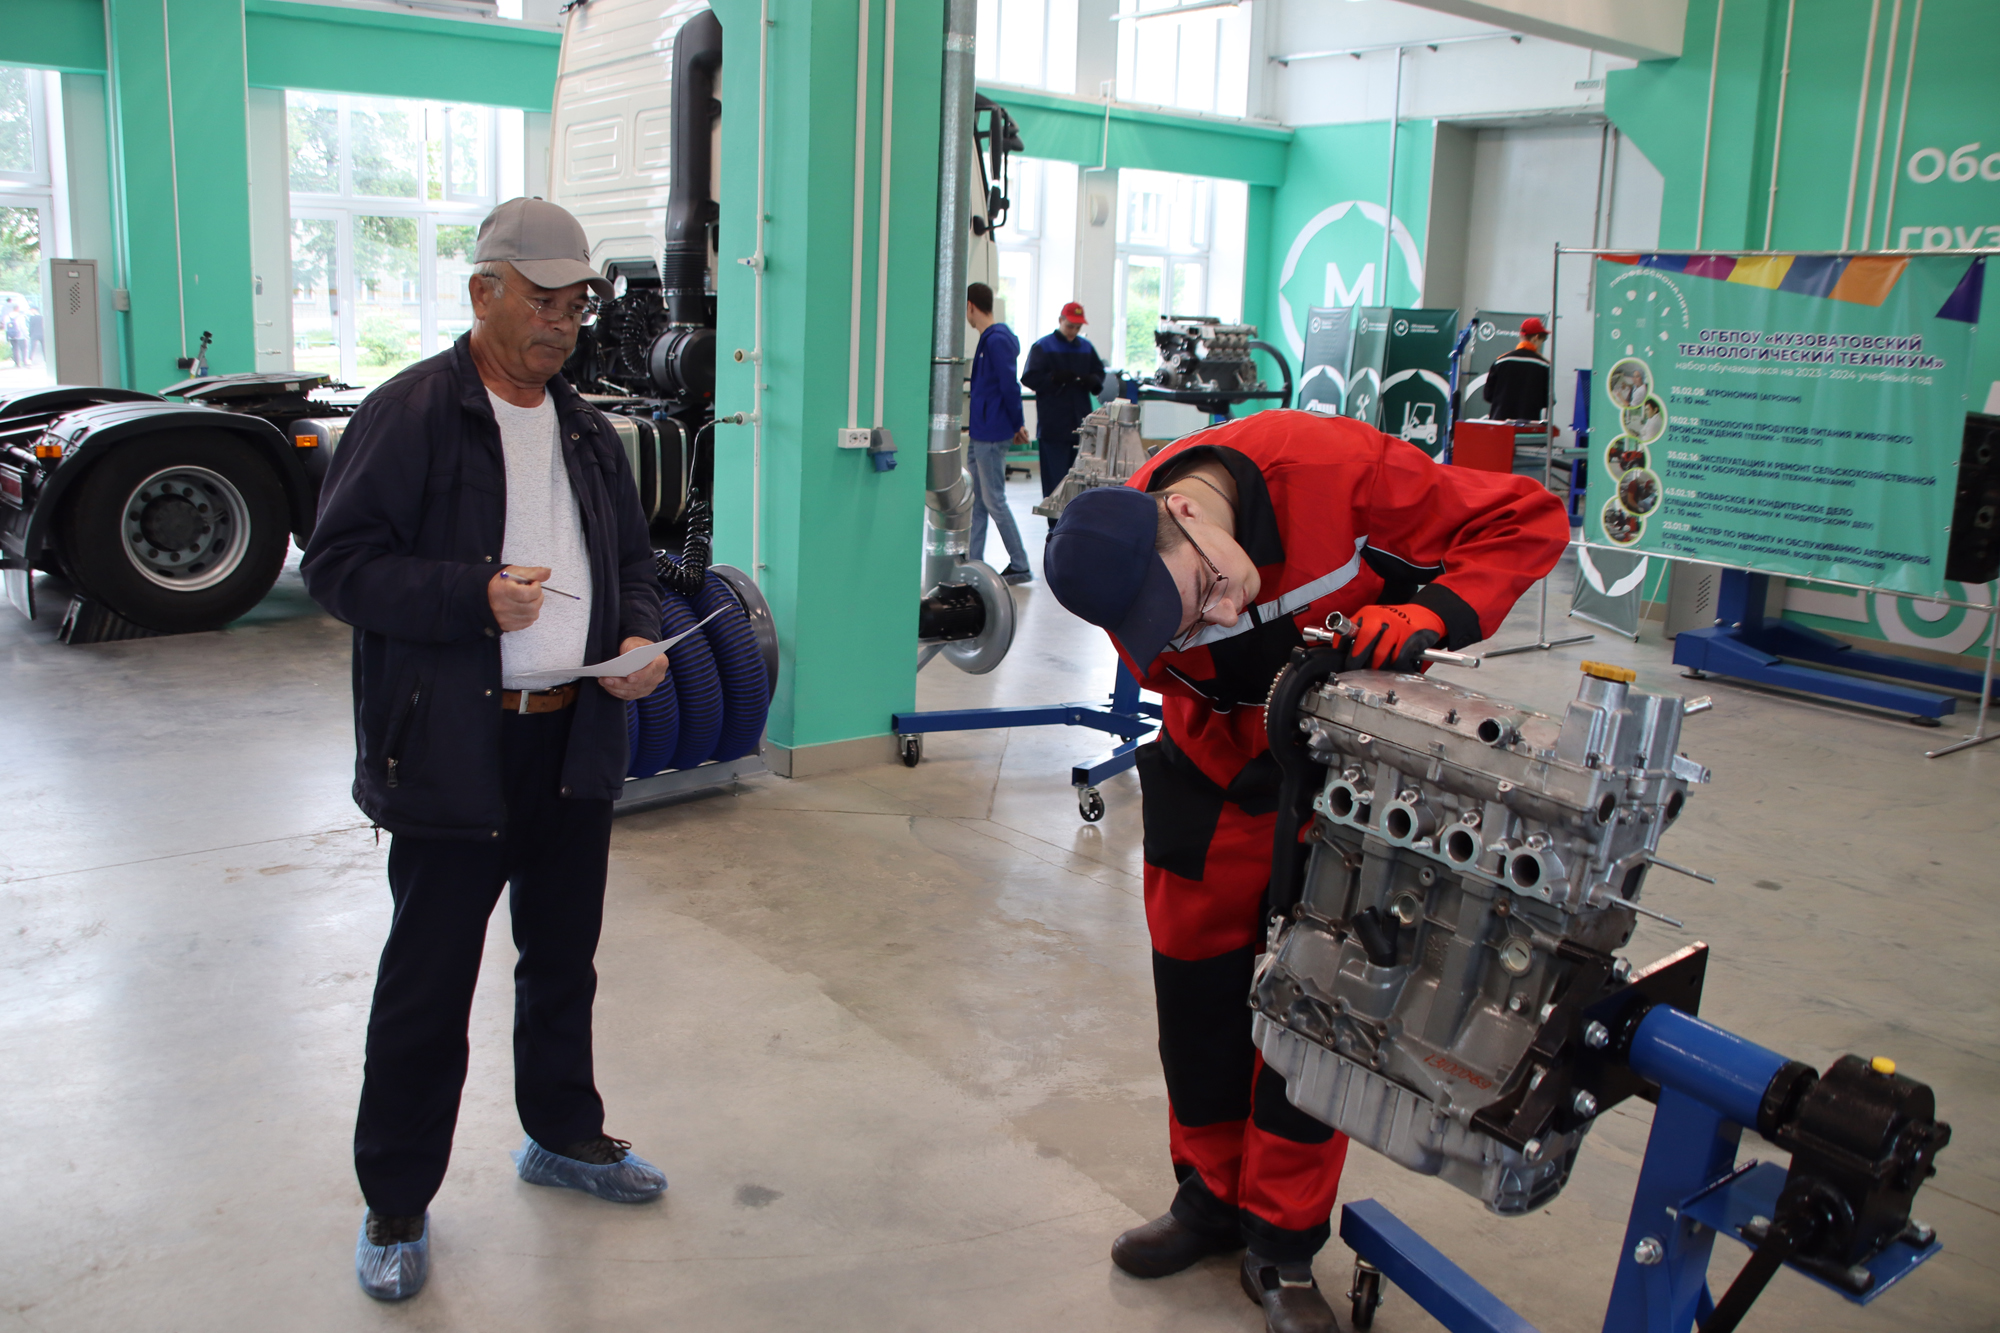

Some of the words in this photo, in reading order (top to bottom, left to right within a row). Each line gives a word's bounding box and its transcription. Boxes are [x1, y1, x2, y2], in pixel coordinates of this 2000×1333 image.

[1609, 268, 1689, 329] ПРОФЕССИОНАЛИТЕТ
[1699, 329, 1761, 345] ОГБПОУ
[1765, 332, 1922, 352] «КУЗОВАТОВСКИЙ
[1678, 343, 1835, 364] ТЕХНОЛОГИЧЕСКИЙ
[1840, 350, 1946, 369] ТЕХНИКУМ»
[1675, 361, 1705, 372] набор
[1707, 362, 1778, 376] обучающихся
[1781, 368, 1794, 377] на
[1796, 367, 1822, 378] 2023
[1829, 369, 1855, 380] 2024
[1858, 371, 1909, 385] учебный
[1911, 376, 1933, 387] год
[1683, 396, 1693, 404] 10
[1705, 389, 1757, 400] АГРОНОМИЯ
[1760, 393, 1802, 404] (АГРОНОМ)
[1669, 426, 1742, 439] ПРОИСХОЖДЕНИЯ
[1681, 435, 1690, 443] 10
[1692, 437, 1709, 445] мес.
[1700, 419, 1753, 431] ТЕХНОЛОГИЯ
[1755, 423, 1809, 435] ПРОДУКТОВ
[1810, 428, 1852, 439] ПИТАНИЯ
[1854, 432, 1914, 445] ЖИВОТНОГО
[1667, 460, 1702, 470] ТЕХНИКИ
[1711, 465, 1780, 480] ОБОРУДОВАНИЯ
[1678, 471, 1687, 479] 10
[1689, 473, 1706, 481] мес.
[1700, 454, 1765, 468] ЭКСПЛУАТАЦИЯ
[1774, 462, 1811, 472] РЕМОНТ
[1812, 465, 1937, 487] СЕЛЬСКОХОЗЯЙСТВЕННОЙ
[1697, 491, 1747, 504] ПОВАРСКОЕ
[1757, 498, 1824, 514] КОНДИТЕРСКОЕ
[1826, 507, 1853, 516] ДЕЛО
[1691, 525, 1722, 535] МАСТЕР
[1724, 530, 1735, 538] ПО
[1737, 532, 1775, 544] РЕМОНТУ
[1785, 537, 1862, 555] ОБСЛУЖИВАНИЮ
[1863, 549, 1931, 565] АВТОМОБИЛЕЙ
[1695, 537, 1705, 545] ПО
